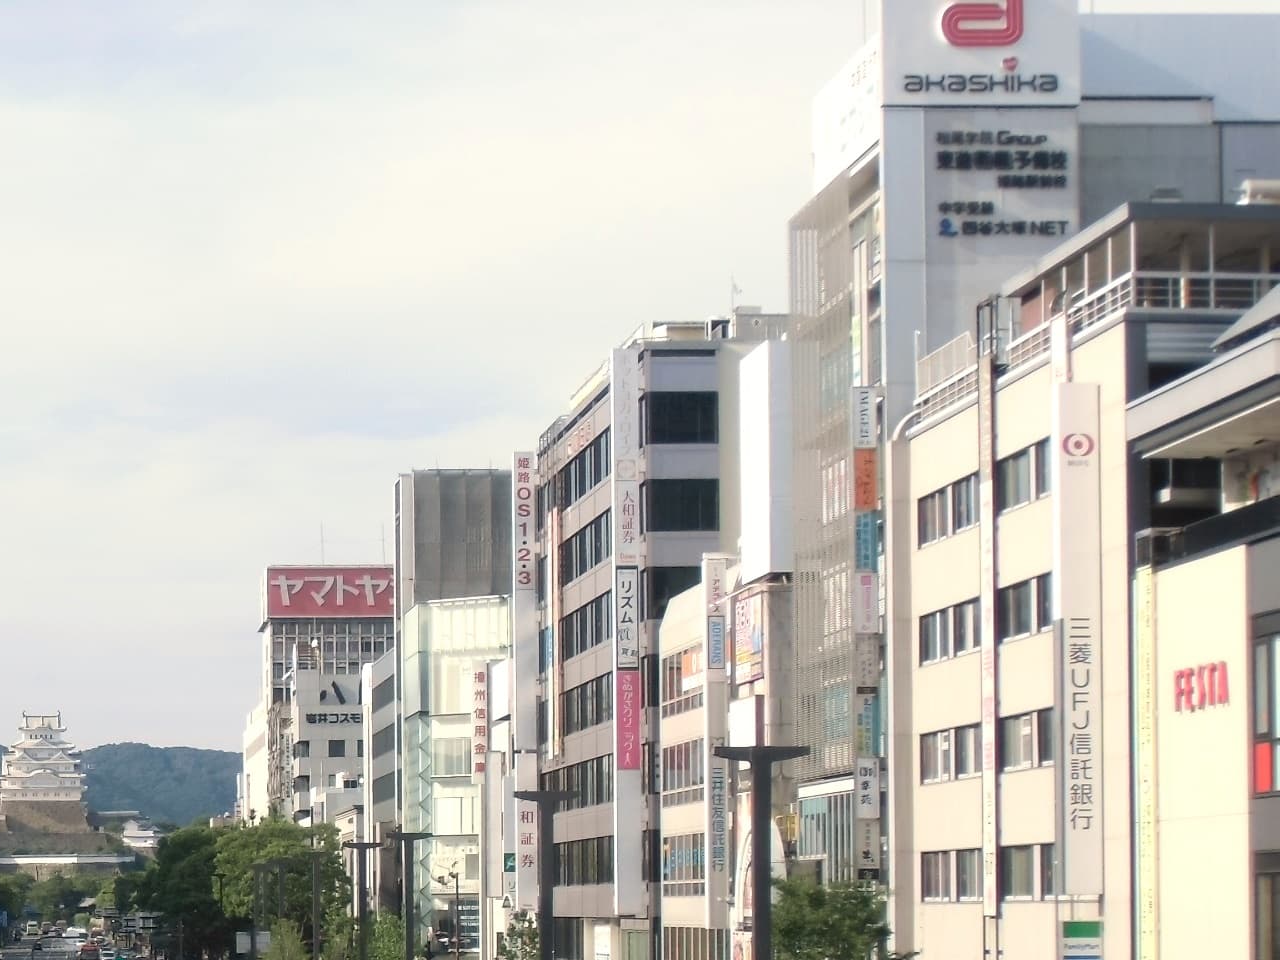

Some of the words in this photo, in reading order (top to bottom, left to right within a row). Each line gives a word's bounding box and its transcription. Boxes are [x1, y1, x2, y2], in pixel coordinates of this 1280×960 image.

[1174, 661, 1229, 712] FESTA
[306, 713, 363, 725] 岩井コスモ
[1070, 617, 1094, 830] 三菱UFJ信託銀行
[520, 809, 534, 868] 和証券
